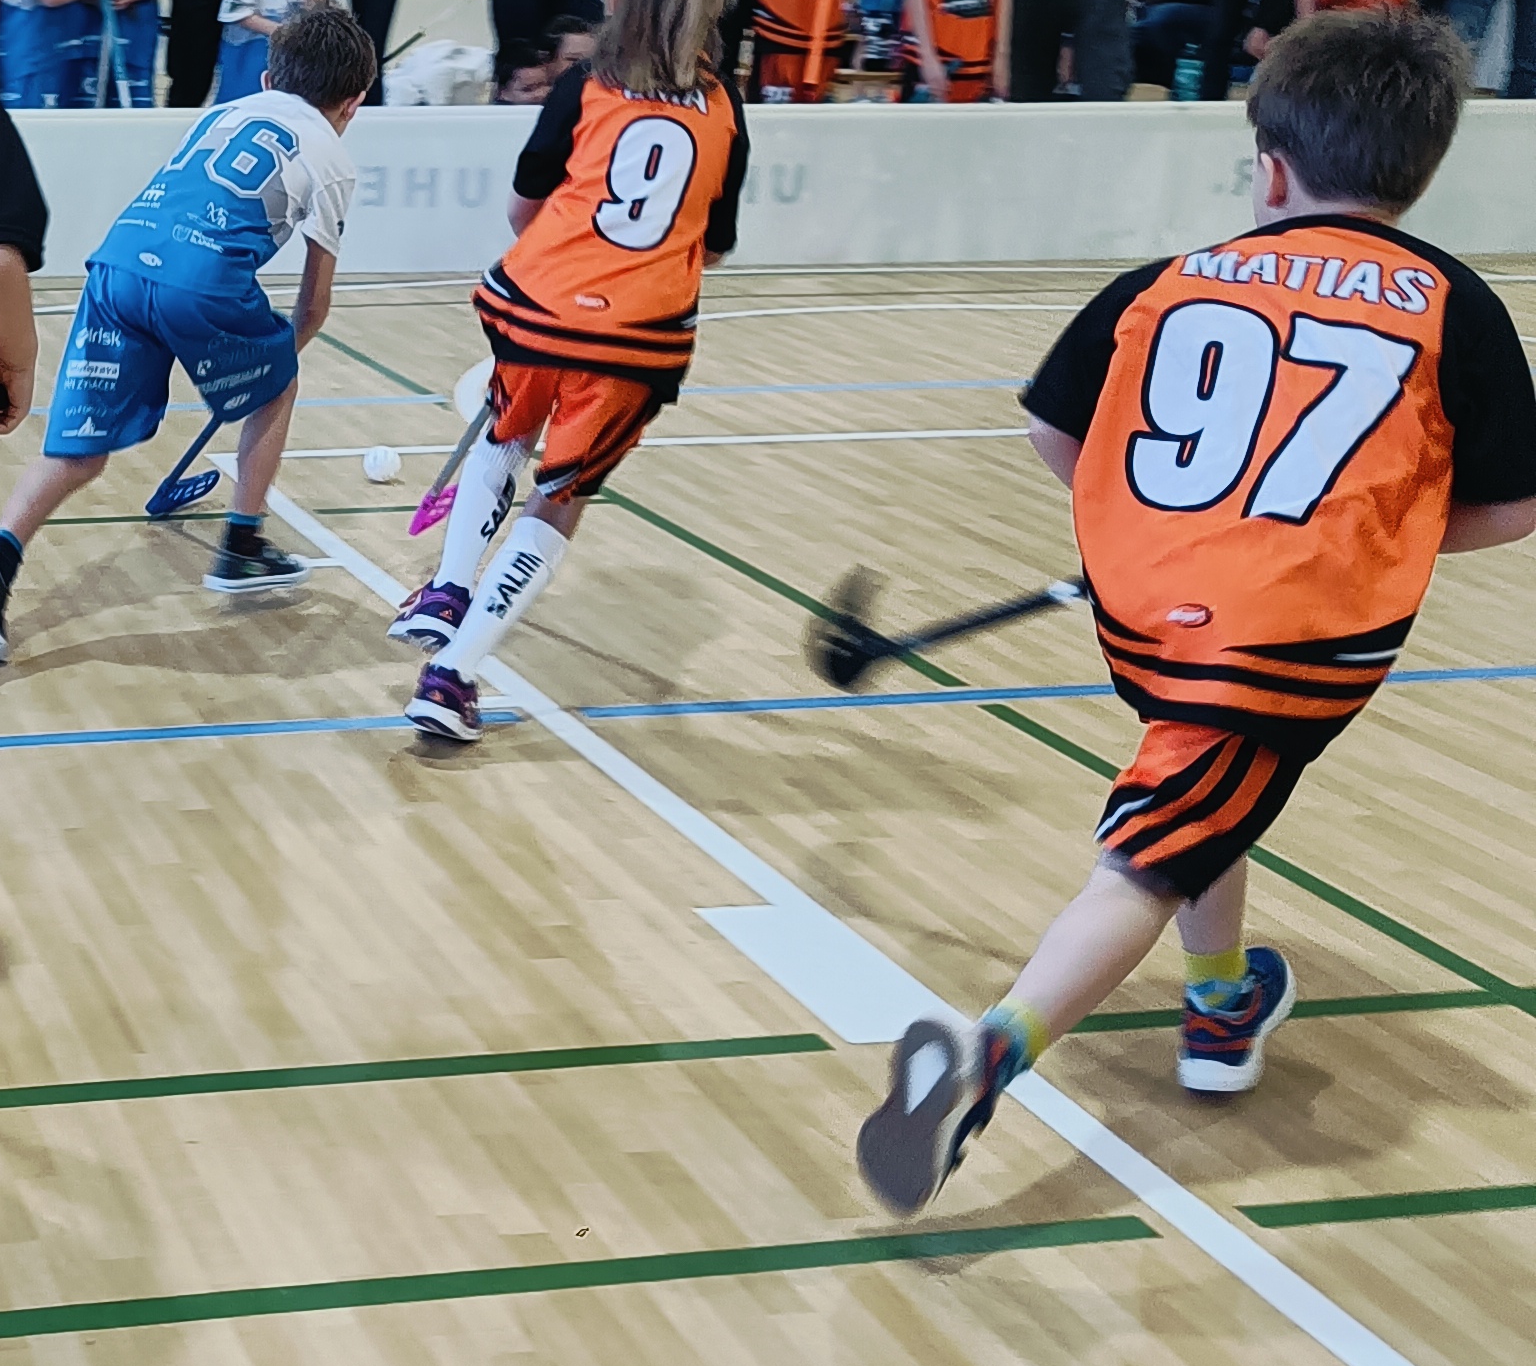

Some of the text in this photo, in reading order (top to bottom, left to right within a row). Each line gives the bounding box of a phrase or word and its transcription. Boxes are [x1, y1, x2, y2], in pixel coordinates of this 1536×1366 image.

[161, 107, 300, 199] 16
[592, 115, 698, 252] 9
[1180, 251, 1437, 315] MATIAS
[1125, 298, 1422, 526] 97
